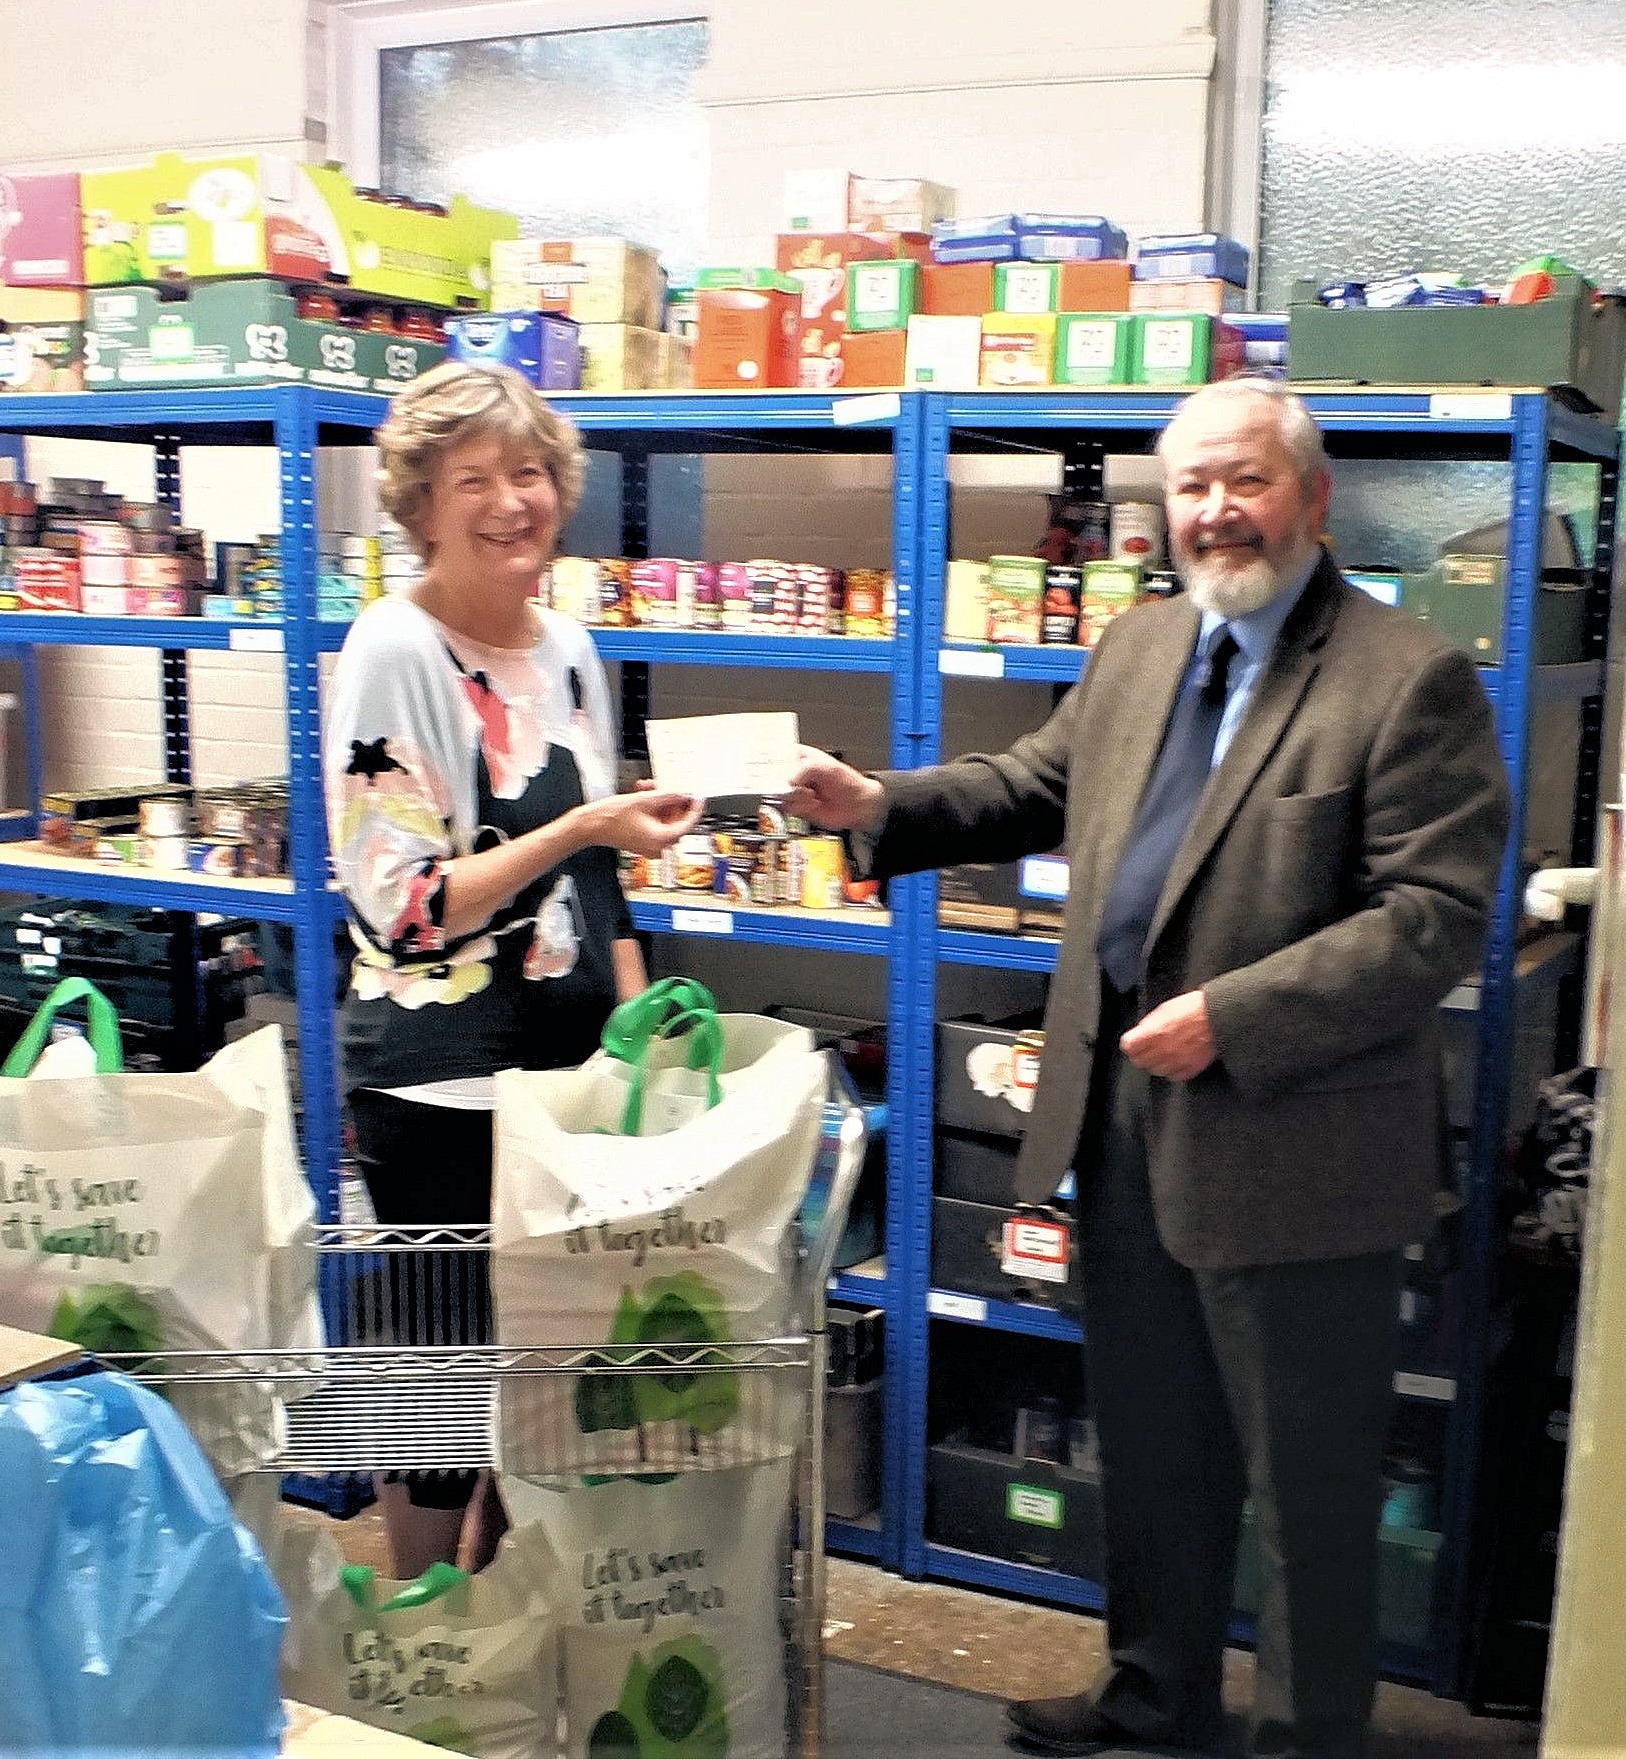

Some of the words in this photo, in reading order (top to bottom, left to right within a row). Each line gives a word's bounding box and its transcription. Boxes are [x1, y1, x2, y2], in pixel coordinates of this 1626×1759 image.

[583, 1548, 641, 1590] Let's
[648, 1549, 704, 1578] save
[612, 1579, 724, 1634] together
